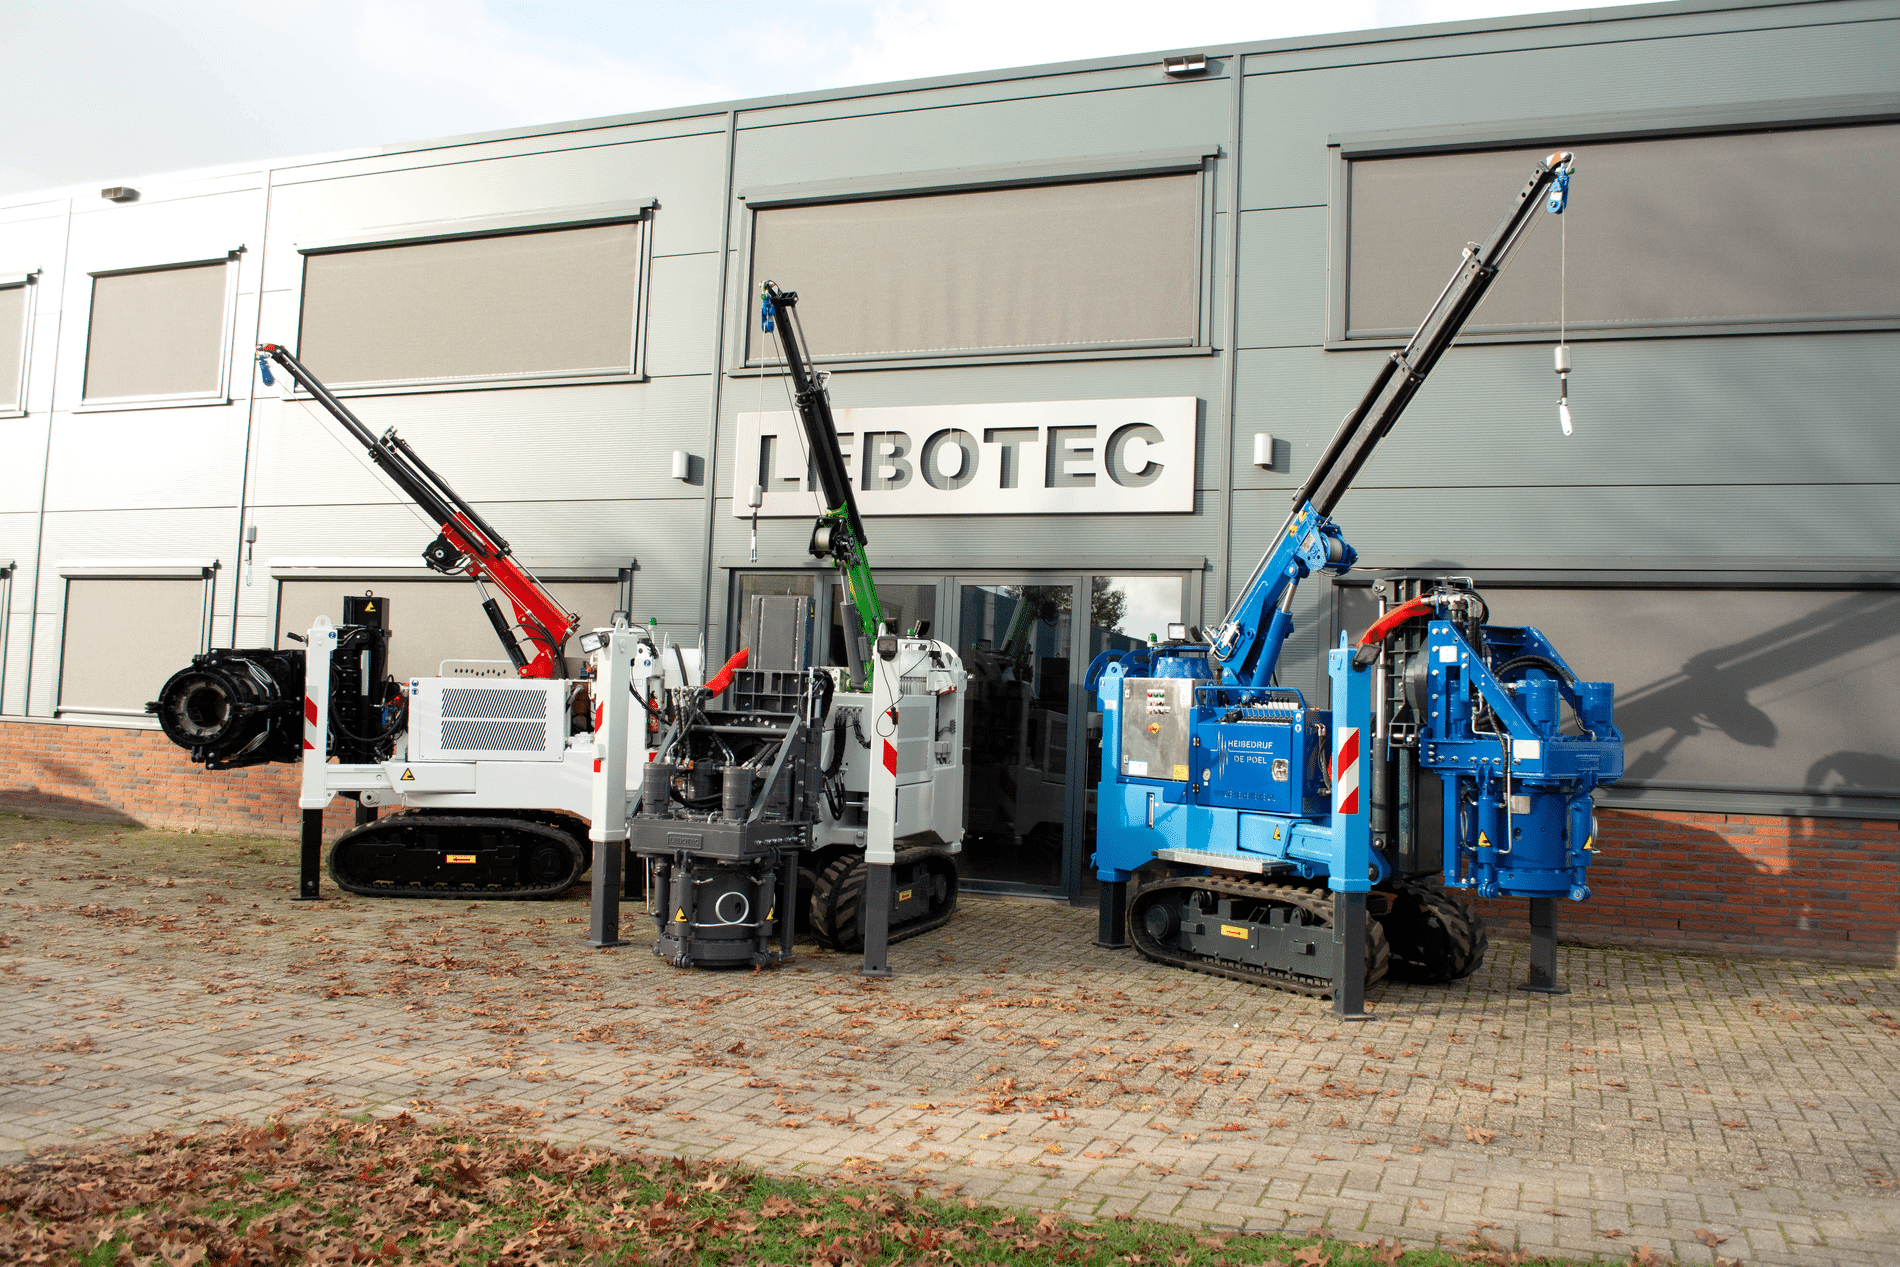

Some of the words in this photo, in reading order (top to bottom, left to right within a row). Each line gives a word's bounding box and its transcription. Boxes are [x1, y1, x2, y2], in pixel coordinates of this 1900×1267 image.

[1227, 740, 1273, 749] HEIBEDRIJF
[1233, 755, 1245, 763] DE
[1246, 756, 1267, 764] POEL
